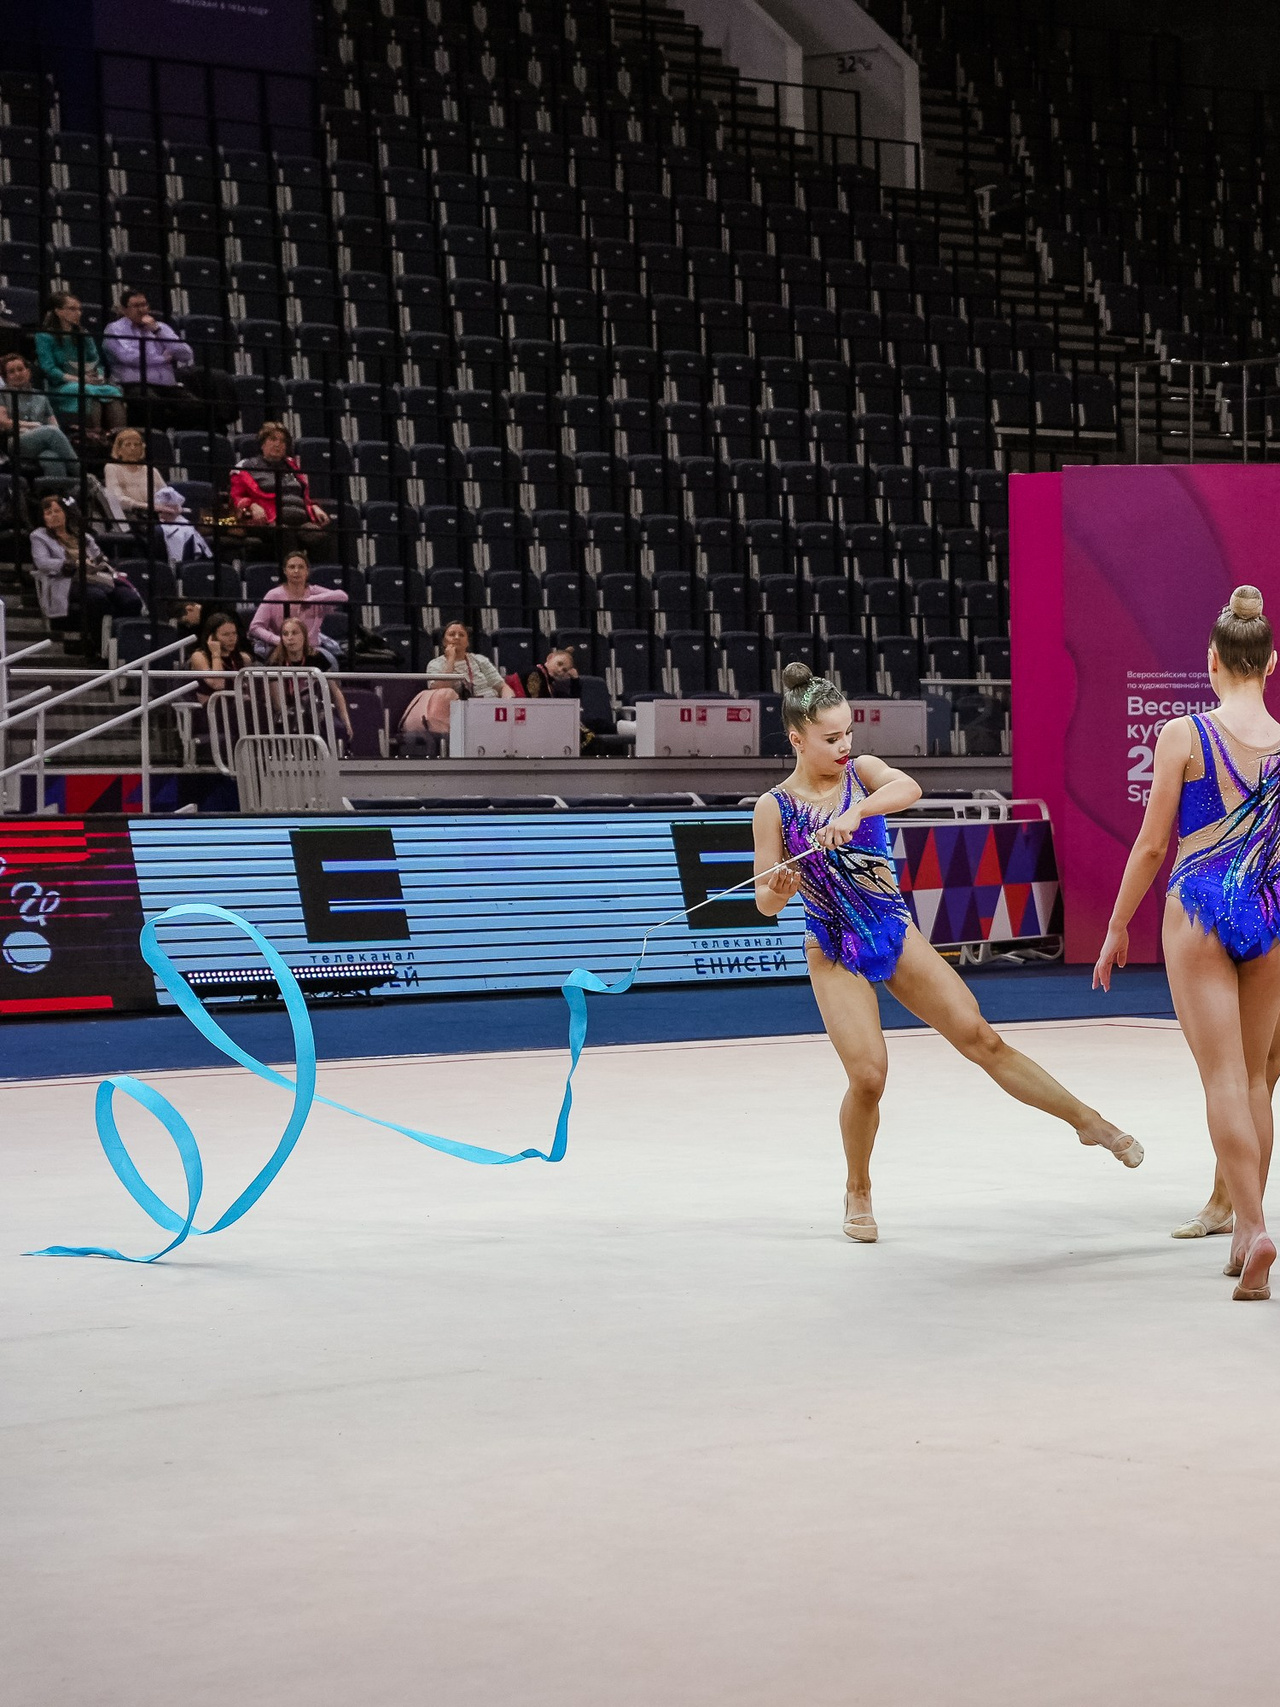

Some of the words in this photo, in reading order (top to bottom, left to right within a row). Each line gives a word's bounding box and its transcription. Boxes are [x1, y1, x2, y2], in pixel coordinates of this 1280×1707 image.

[1126, 671, 1187, 679] Всероссийские
[1188, 671, 1209, 679] соре
[1138, 682, 1200, 690] художественной
[1127, 696, 1220, 716] Весенн
[1127, 719, 1167, 744] куб
[691, 937, 783, 949] телеканал
[310, 951, 415, 964] телеканал
[694, 951, 787, 975] ЕНИСЕЙ
